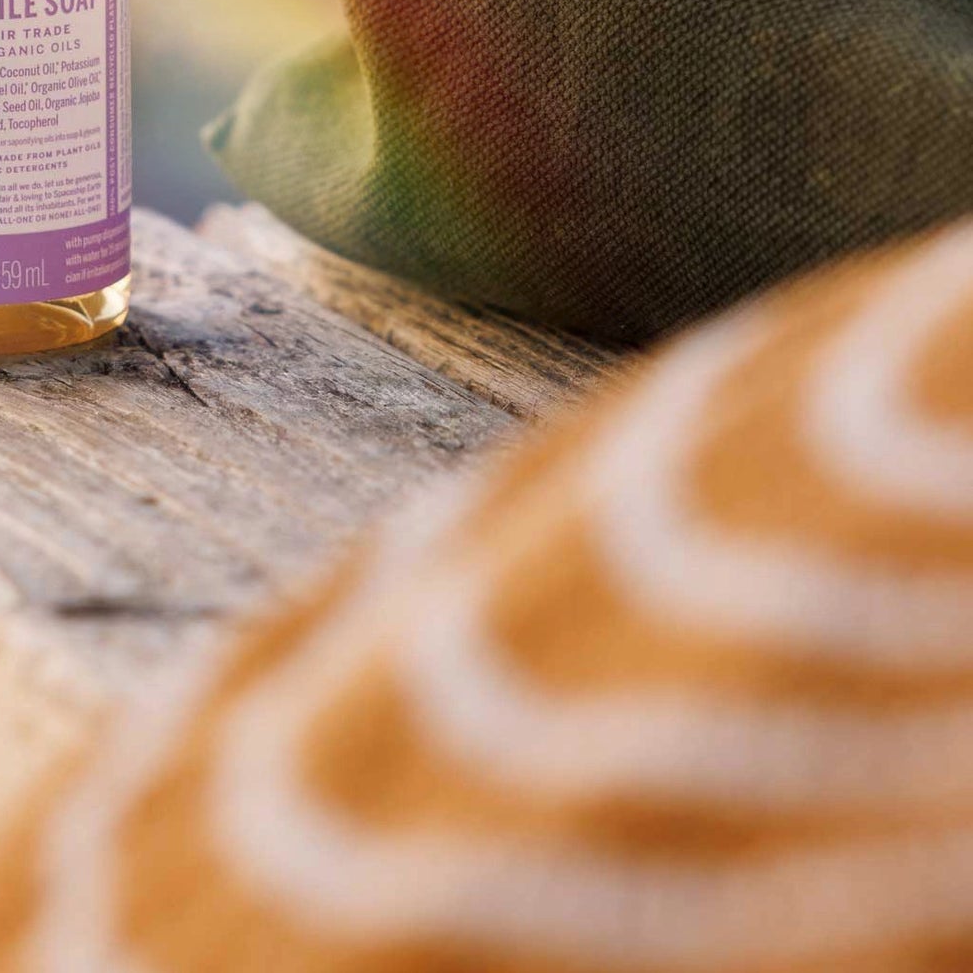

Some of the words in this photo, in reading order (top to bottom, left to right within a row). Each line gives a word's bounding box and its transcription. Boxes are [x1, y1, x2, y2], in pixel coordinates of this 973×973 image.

[23, 24, 71, 39] TRADE
[51, 39, 81, 53] OILS
[0, 63, 40, 78] Coconut
[61, 57, 100, 72] Potassium
[31, 79, 66, 95] Organic
[68, 76, 87, 89] Olive
[3, 100, 26, 113] Seed
[28, 98, 44, 111] Oil,
[45, 94, 77, 111] Organic
[8, 114, 59, 131] Tocopherol
[27, 151, 53, 160] FROM
[56, 146, 83, 157] PLANT
[85, 141, 101, 151] OILS
[6, 161, 68, 174] DETERGENTS
[66, 177, 74, 185] be
[45, 191, 52, 199] to
[14, 205, 23, 213] all
[25, 204, 34, 212] its
[35, 214, 47, 222] OR
[1, 260, 22, 289] 59
[26, 259, 50, 288] mL
